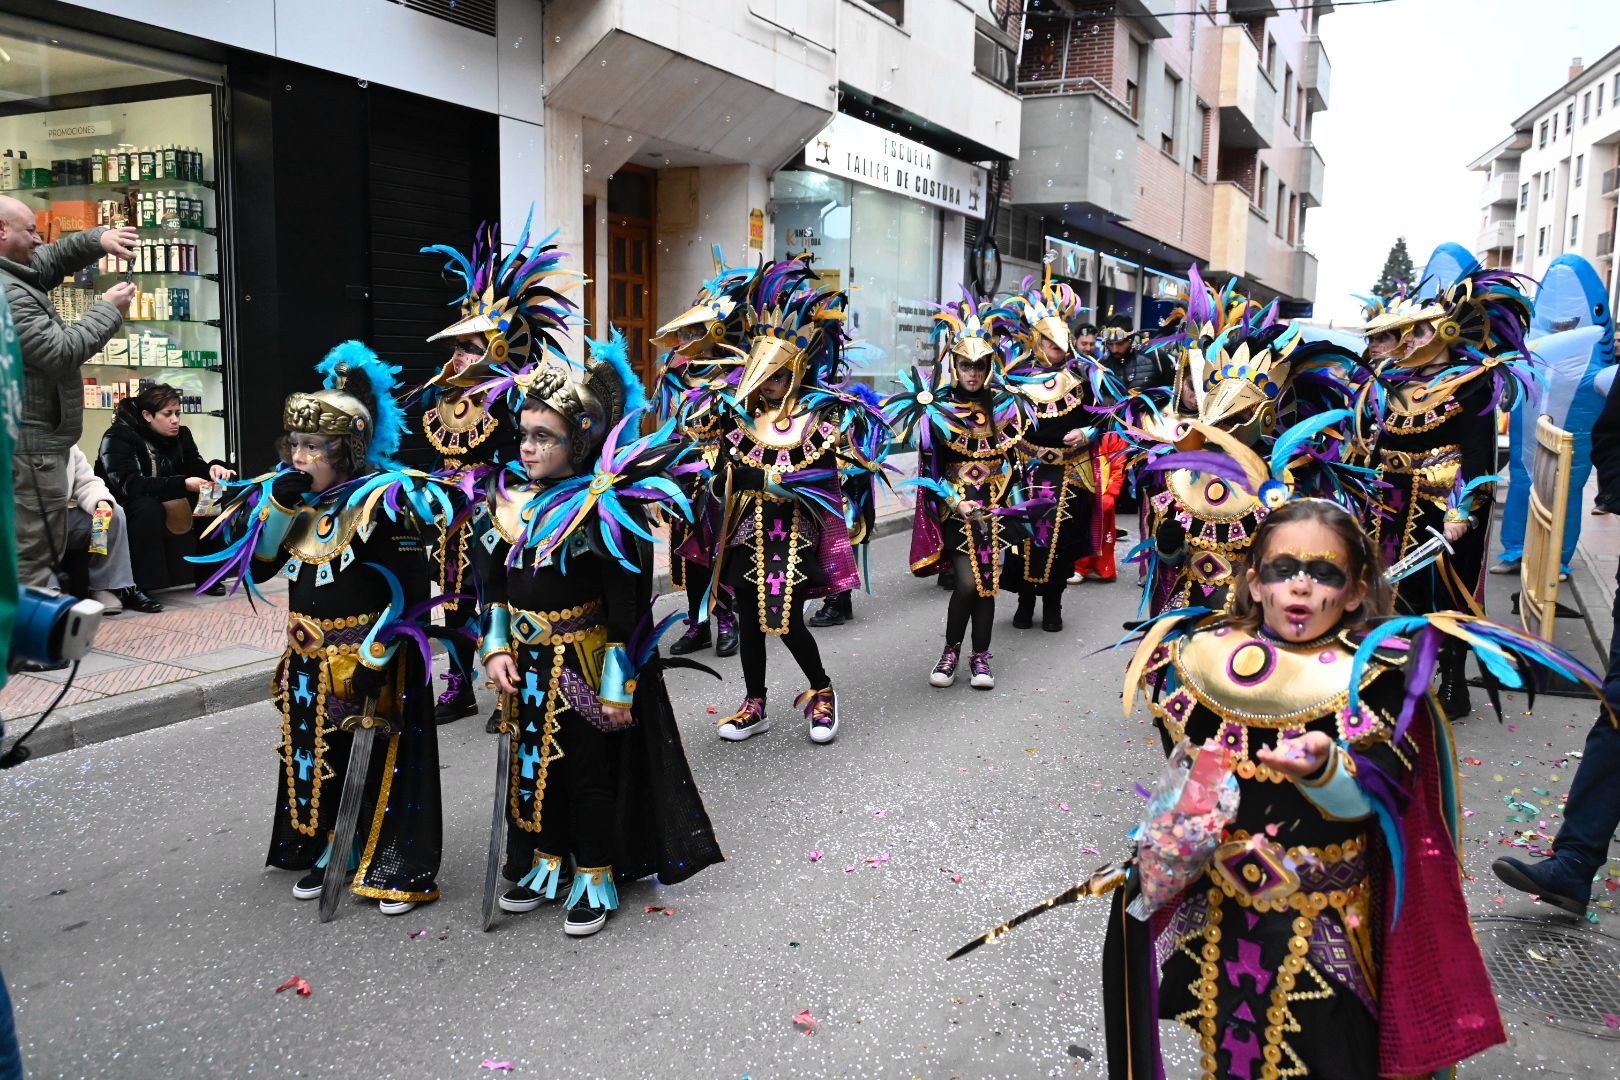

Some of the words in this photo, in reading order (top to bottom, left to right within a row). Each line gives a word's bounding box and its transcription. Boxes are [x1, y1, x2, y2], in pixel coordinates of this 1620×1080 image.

[48, 125, 96, 138] PROMOCIONES
[884, 137, 932, 171] ESCUELA
[847, 152, 889, 183] TALLER
[896, 169, 909, 189] DE
[915, 175, 961, 206] COSTURA
